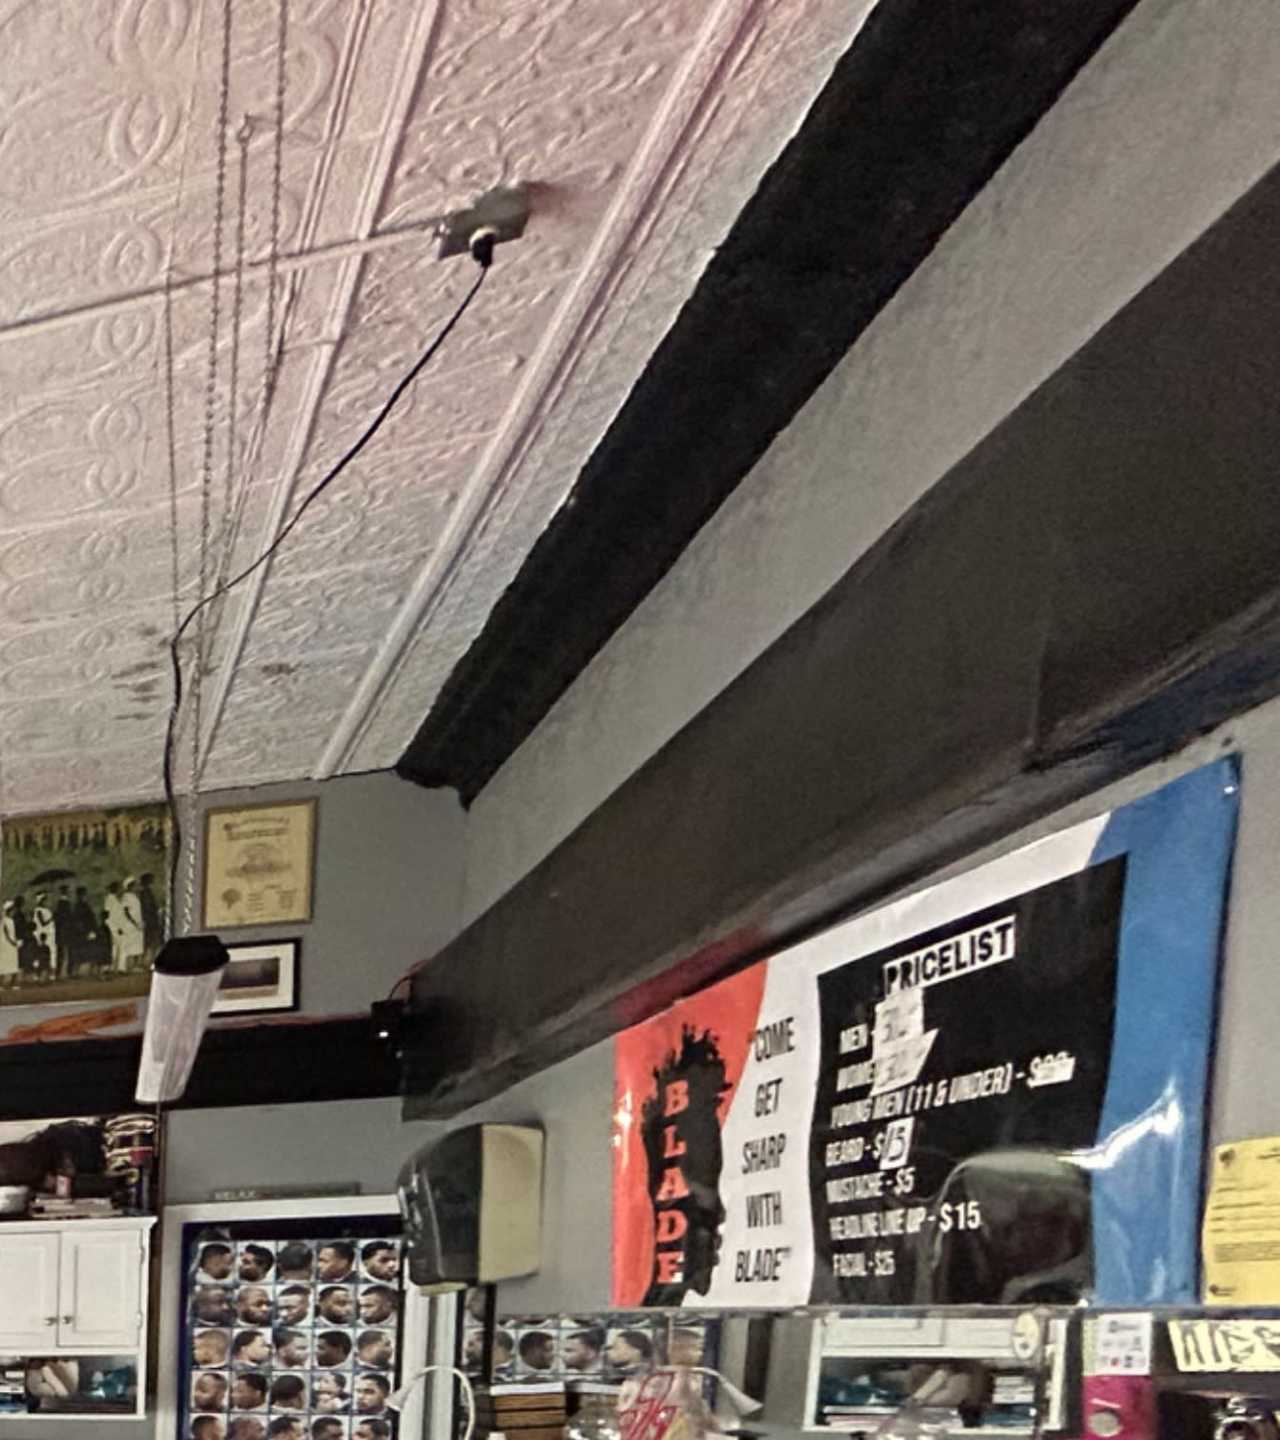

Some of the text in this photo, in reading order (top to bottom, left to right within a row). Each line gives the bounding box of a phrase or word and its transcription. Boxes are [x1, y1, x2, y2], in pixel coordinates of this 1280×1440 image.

[885, 922, 1013, 994] PRICELIST
[840, 1024, 868, 1054] MEN
[837, 1060, 876, 1091] WOME
[755, 1078, 783, 1117] GET
[831, 1099, 871, 1129] YOUNG
[871, 1090, 904, 1120] MEN
[742, 1133, 787, 1174] SHARP
[826, 1136, 863, 1167] BEARD
[655, 1079, 689, 1284] BLADE
[894, 1167, 917, 1197] $5
[746, 1191, 783, 1228] WITH
[939, 1200, 982, 1233] $15
